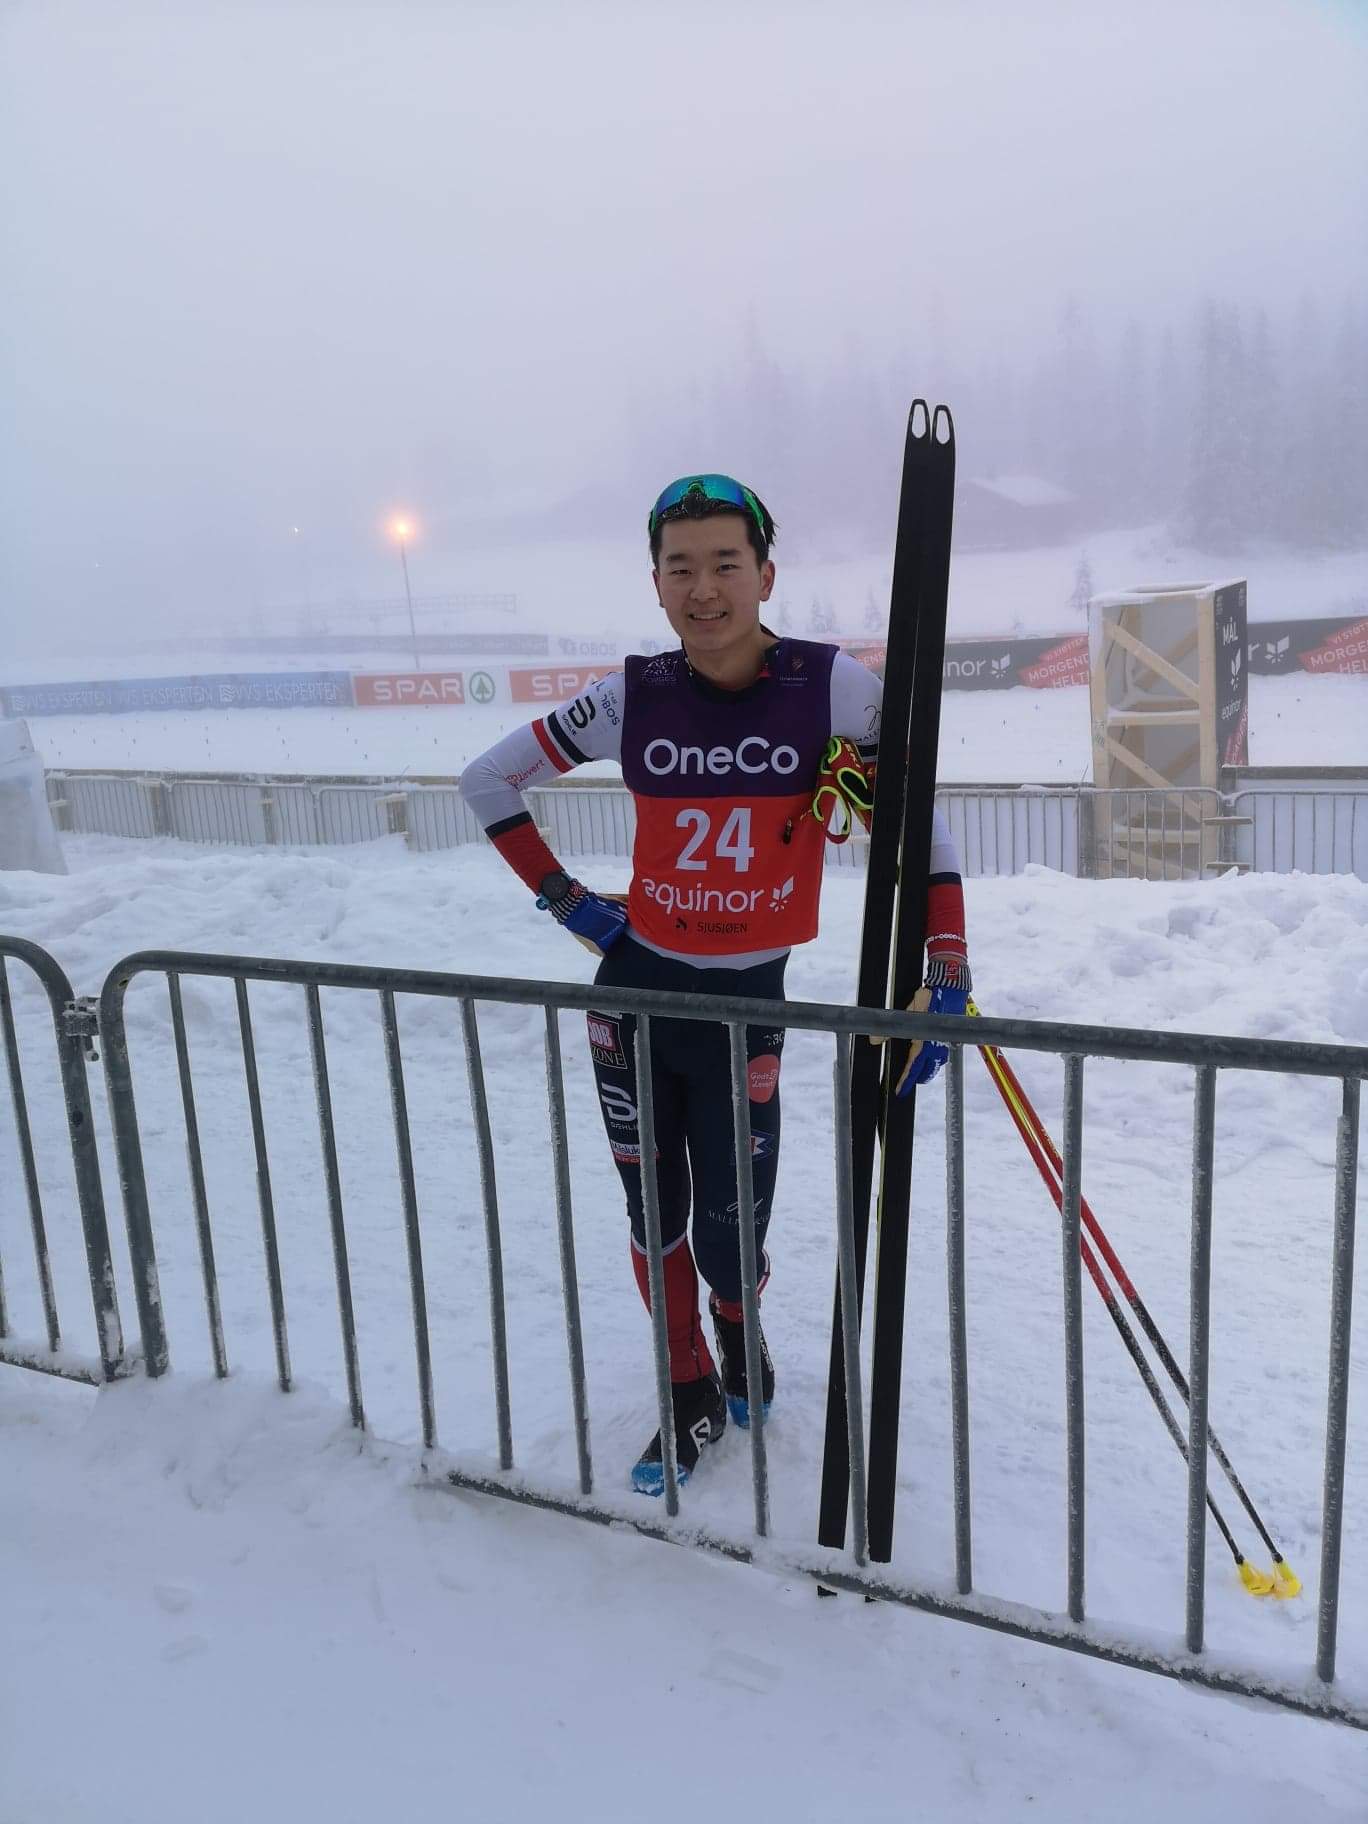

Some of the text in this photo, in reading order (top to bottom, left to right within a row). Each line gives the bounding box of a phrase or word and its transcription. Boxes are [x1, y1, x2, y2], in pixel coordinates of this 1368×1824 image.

[1222, 616, 1239, 646] MÅL
[373, 678, 464, 701] SPAR
[532, 671, 602, 697] SPA
[1053, 671, 1089, 689] HELT
[643, 736, 800, 776] OneCo
[674, 807, 755, 873] 24
[697, 921, 748, 934] SJUSJØEN
[592, 1045, 625, 1066] ZONE
